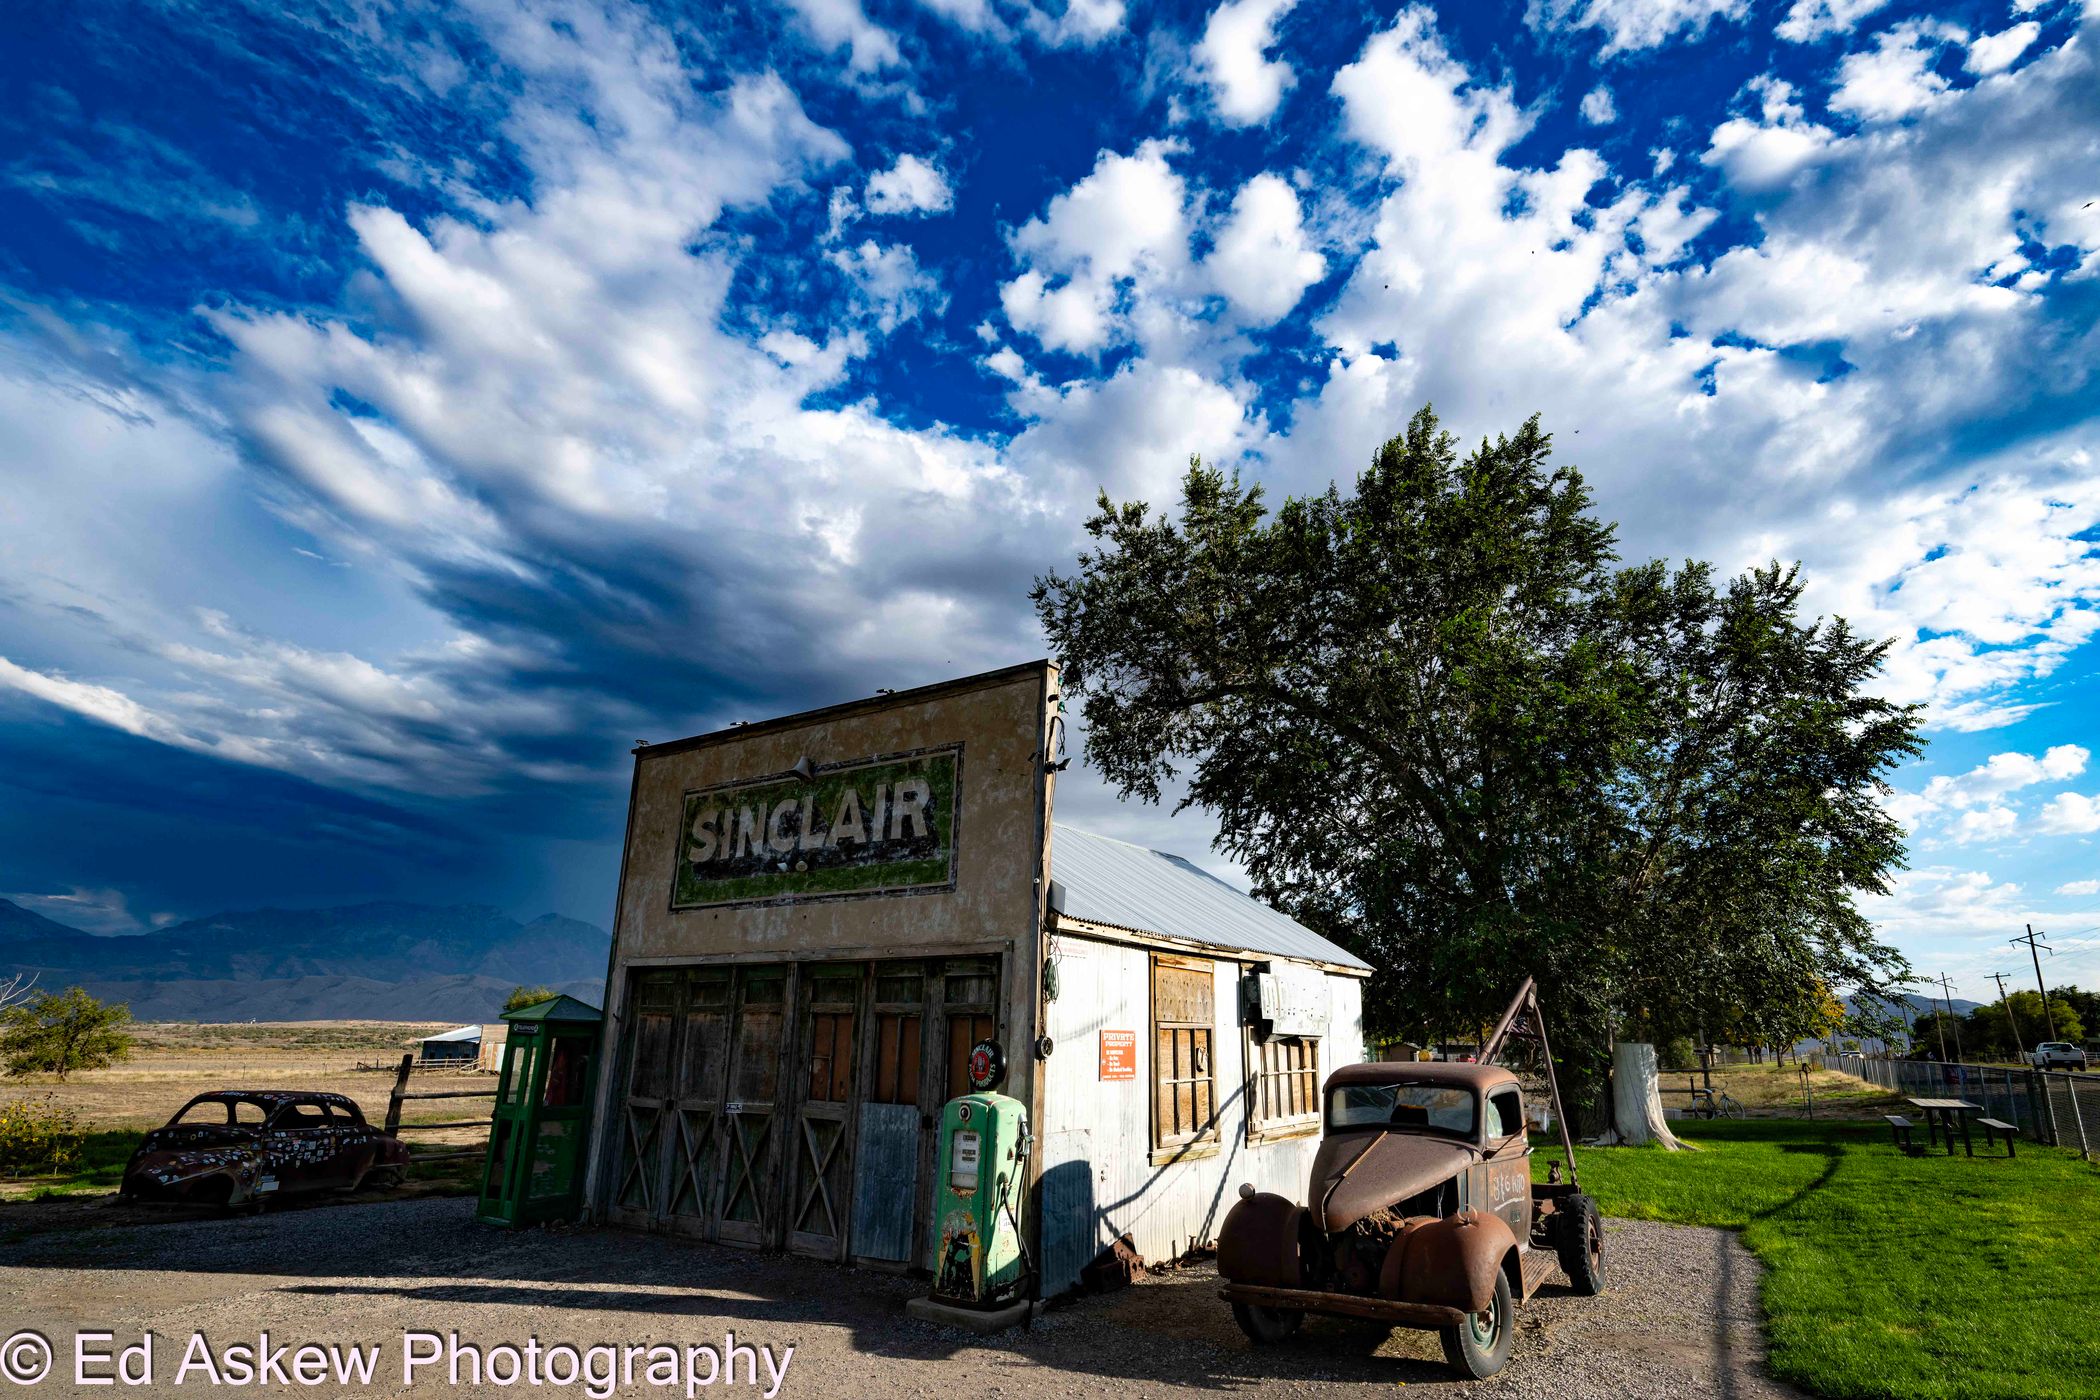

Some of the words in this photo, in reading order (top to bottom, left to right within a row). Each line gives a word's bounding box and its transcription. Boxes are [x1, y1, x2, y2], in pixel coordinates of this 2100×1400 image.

[688, 778, 932, 863] SINCLAIR
[1104, 1033, 1134, 1041] PRIVATE
[972, 1044, 994, 1058] SINCLAIR
